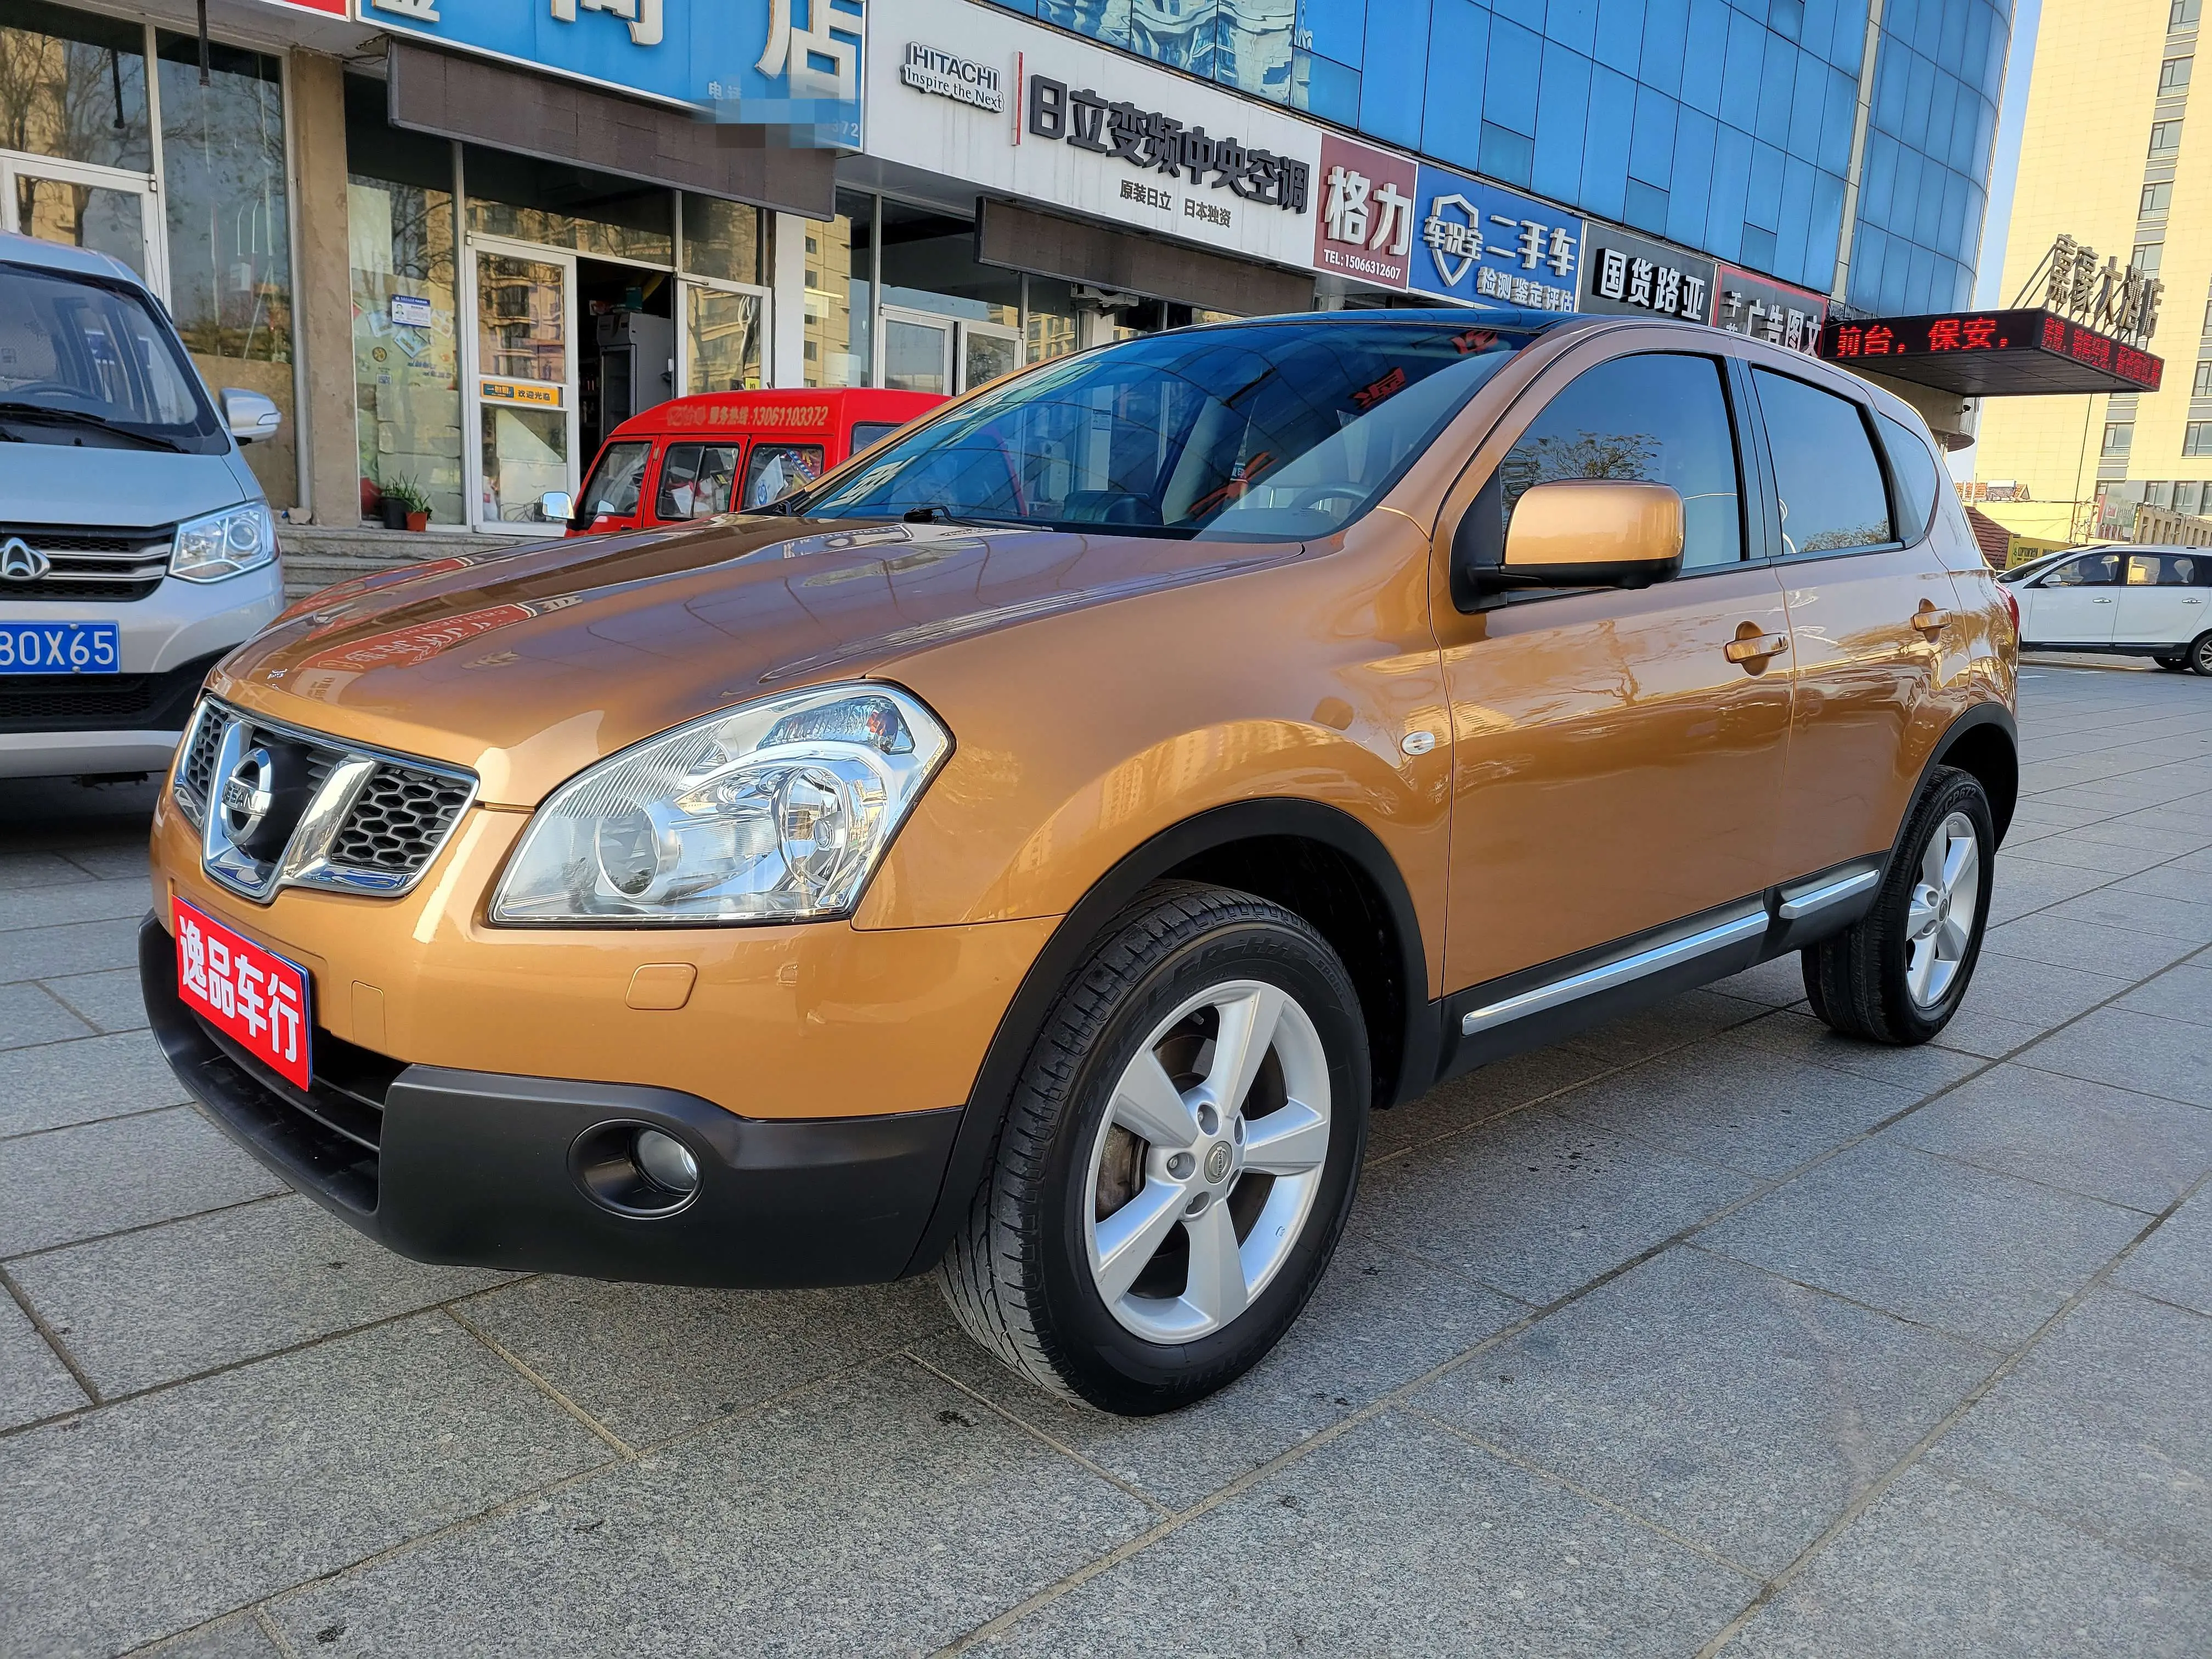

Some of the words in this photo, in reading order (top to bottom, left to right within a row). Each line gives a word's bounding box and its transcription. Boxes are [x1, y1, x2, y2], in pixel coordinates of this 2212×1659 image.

[907, 67, 949, 92] Inspire
[953, 82, 972, 99] the
[974, 88, 1003, 109] Next
[913, 45, 997, 91] HITACHI
[1029, 74, 1310, 214] 日立变频中央空调
[1120, 179, 1172, 211] 原装日立
[1184, 198, 1231, 228] 日本独资
[1324, 165, 1412, 256] 格力
[1423, 215, 1483, 261] 车况宝
[1486, 215, 1577, 276] 二手车
[1323, 249, 1401, 280] TEL:15066312607
[1477, 266, 1573, 312] 检测鉴定评估
[1600, 248, 1705, 321] 国货路亚
[1747, 298, 1821, 357] 广告图文
[1945, 786, 1977, 811] CP672
[179, 915, 299, 1063] 逸品车行
